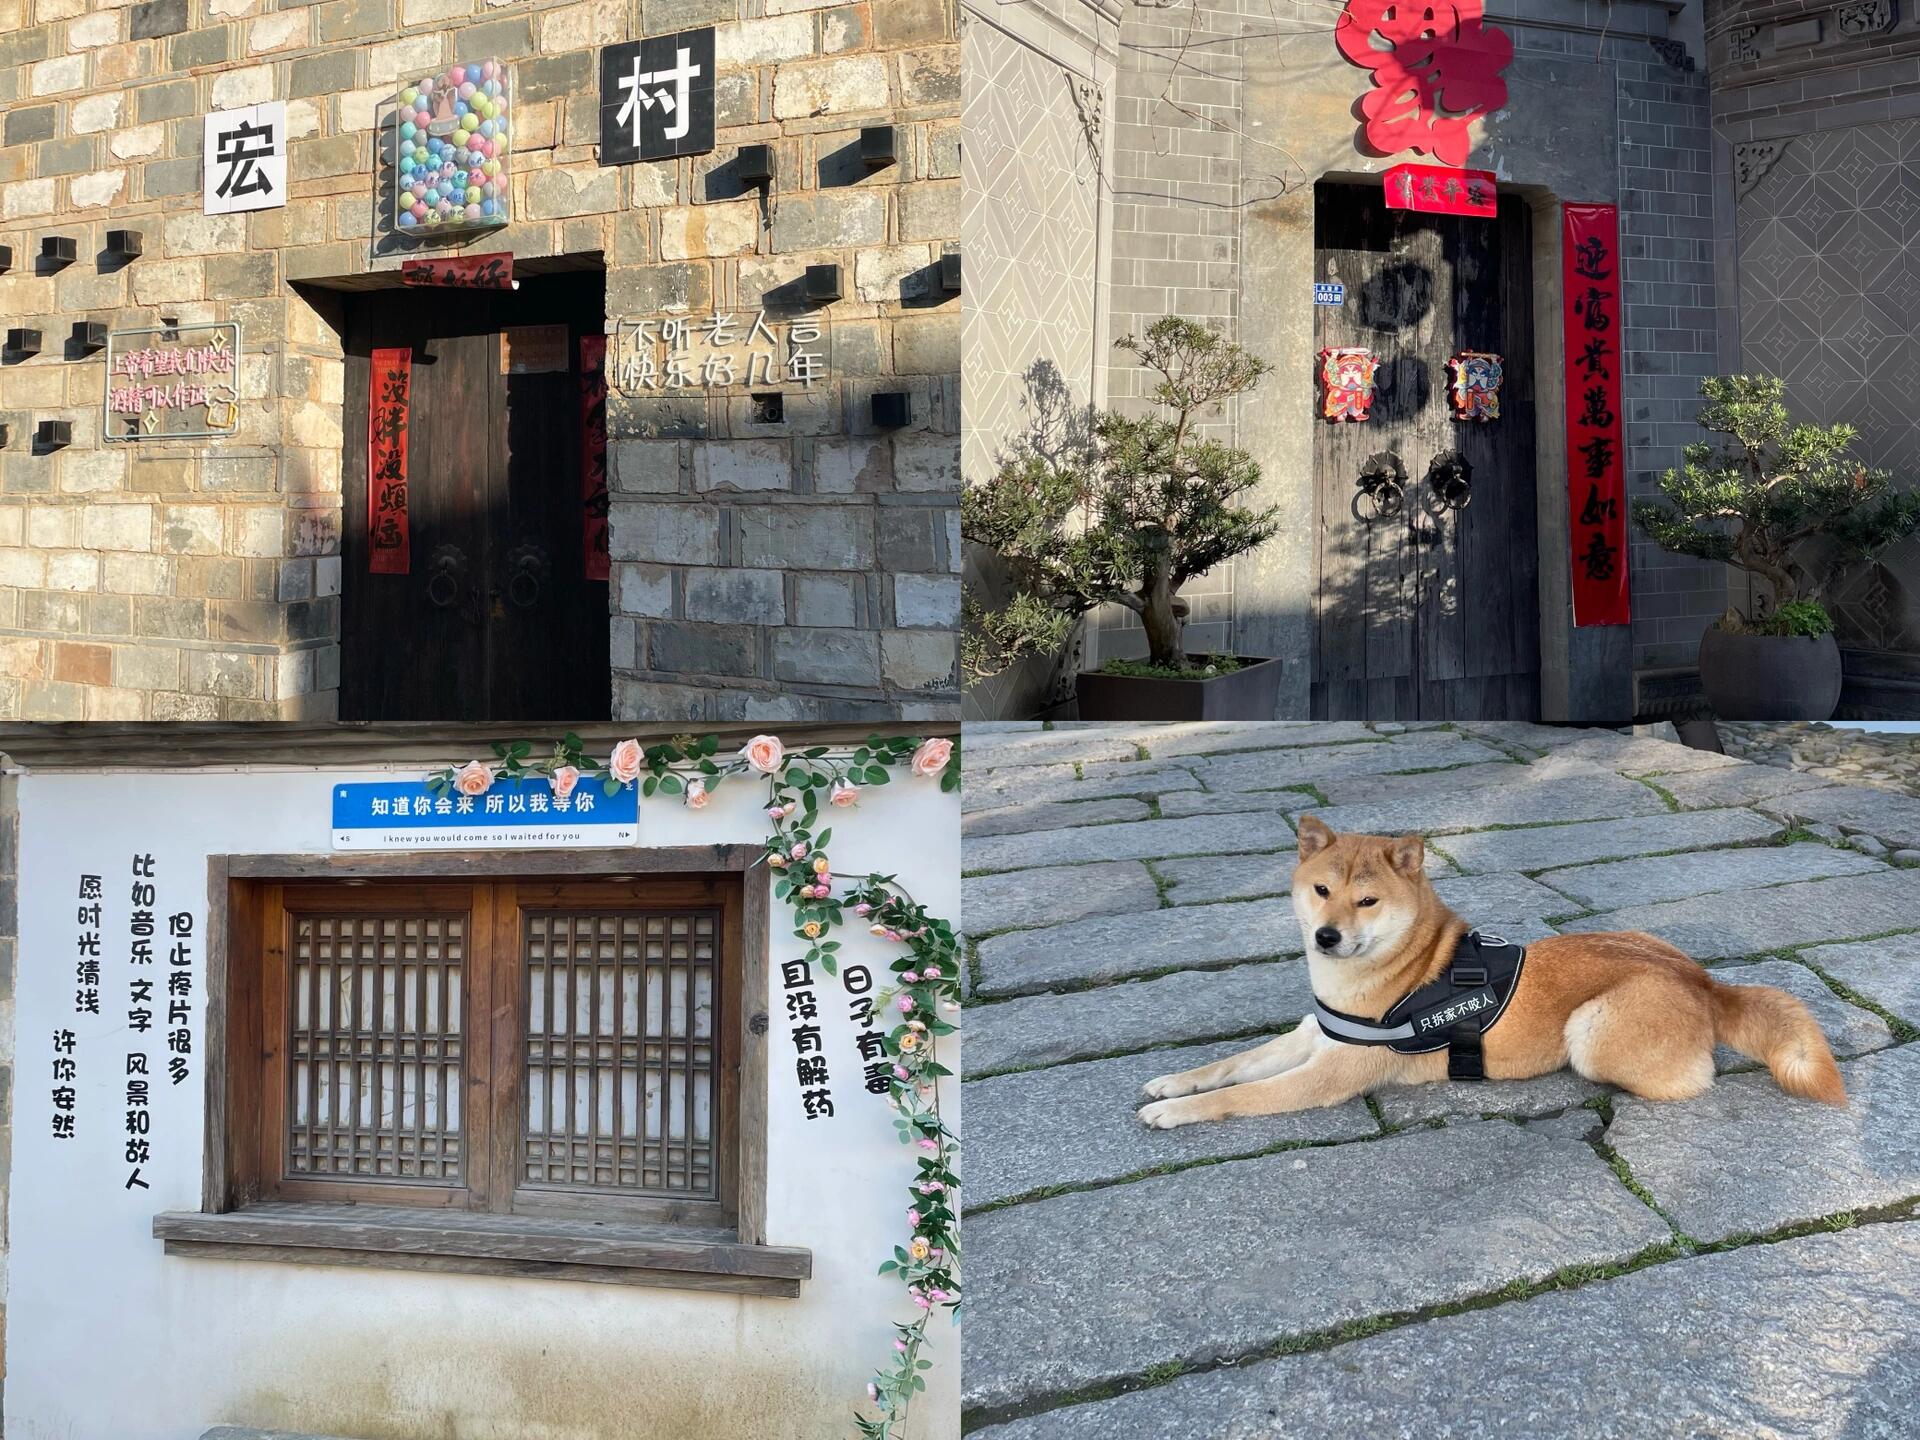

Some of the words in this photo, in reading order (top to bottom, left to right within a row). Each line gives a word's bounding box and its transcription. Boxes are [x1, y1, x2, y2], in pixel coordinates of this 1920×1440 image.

[616, 47, 700, 147] 村
[216, 120, 274, 198] 宏
[1318, 293, 1333, 302] 003
[623, 309, 823, 350] 不听老人言
[110, 345, 235, 381] 上帝希望我们快乐
[625, 347, 826, 390] 快乐好几年
[110, 383, 206, 413] 酒精可以作证
[371, 796, 474, 816] 知道你会来
[485, 791, 594, 813] 所以我等你
[415, 836, 431, 844] you
[433, 834, 461, 842] would
[510, 832, 543, 840] waited
[545, 832, 560, 840] for
[562, 833, 580, 841] you
[130, 853, 155, 965] 比如音乐
[75, 874, 103, 1015] 愿时光清浅
[128, 978, 153, 1033] 文字
[168, 911, 193, 1085] 但止疼片很多
[1420, 993, 1494, 1032] 只拆家不咬人
[781, 958, 834, 1120] 且没有解药
[52, 1029, 76, 1139] 许你安然
[125, 1053, 150, 1190] 风景和故人
